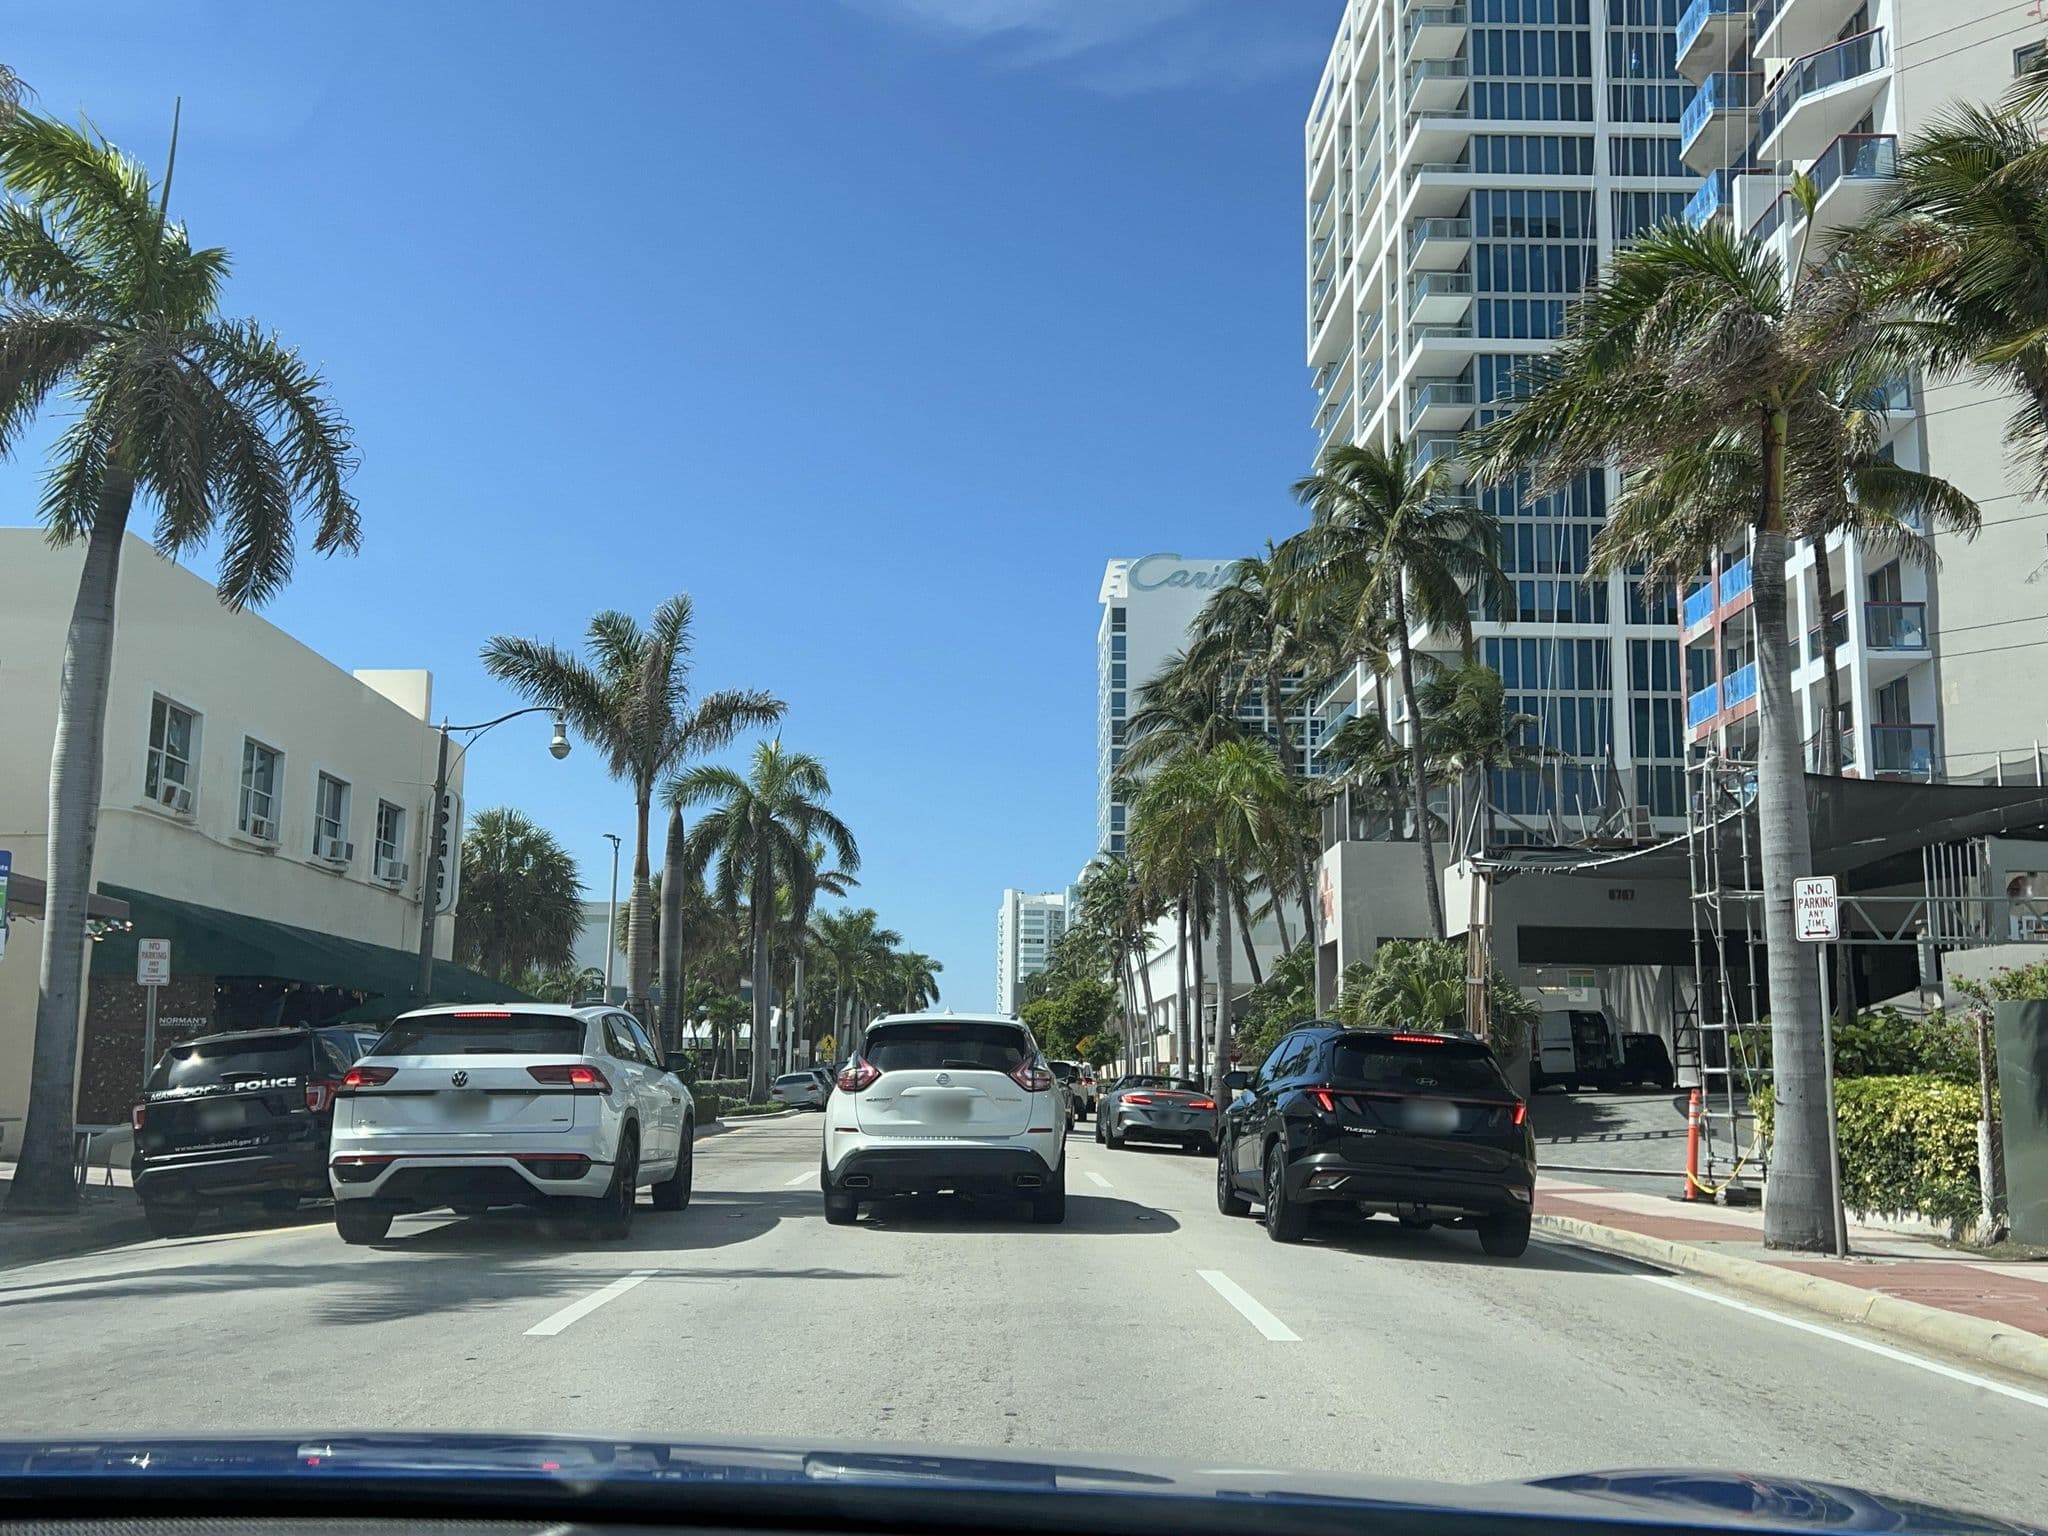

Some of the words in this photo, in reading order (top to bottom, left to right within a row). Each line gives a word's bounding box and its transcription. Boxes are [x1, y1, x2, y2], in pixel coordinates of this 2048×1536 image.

[1129, 552, 1241, 592] Caril
[1807, 883, 1823, 895] NO
[1798, 896, 1834, 909] PARKING
[1808, 910, 1824, 918] ANY
[1808, 918, 1827, 927] TIME
[149, 942, 160, 950] NO
[141, 951, 167, 960] PARKING
[234, 1077, 297, 1092] POLICE
